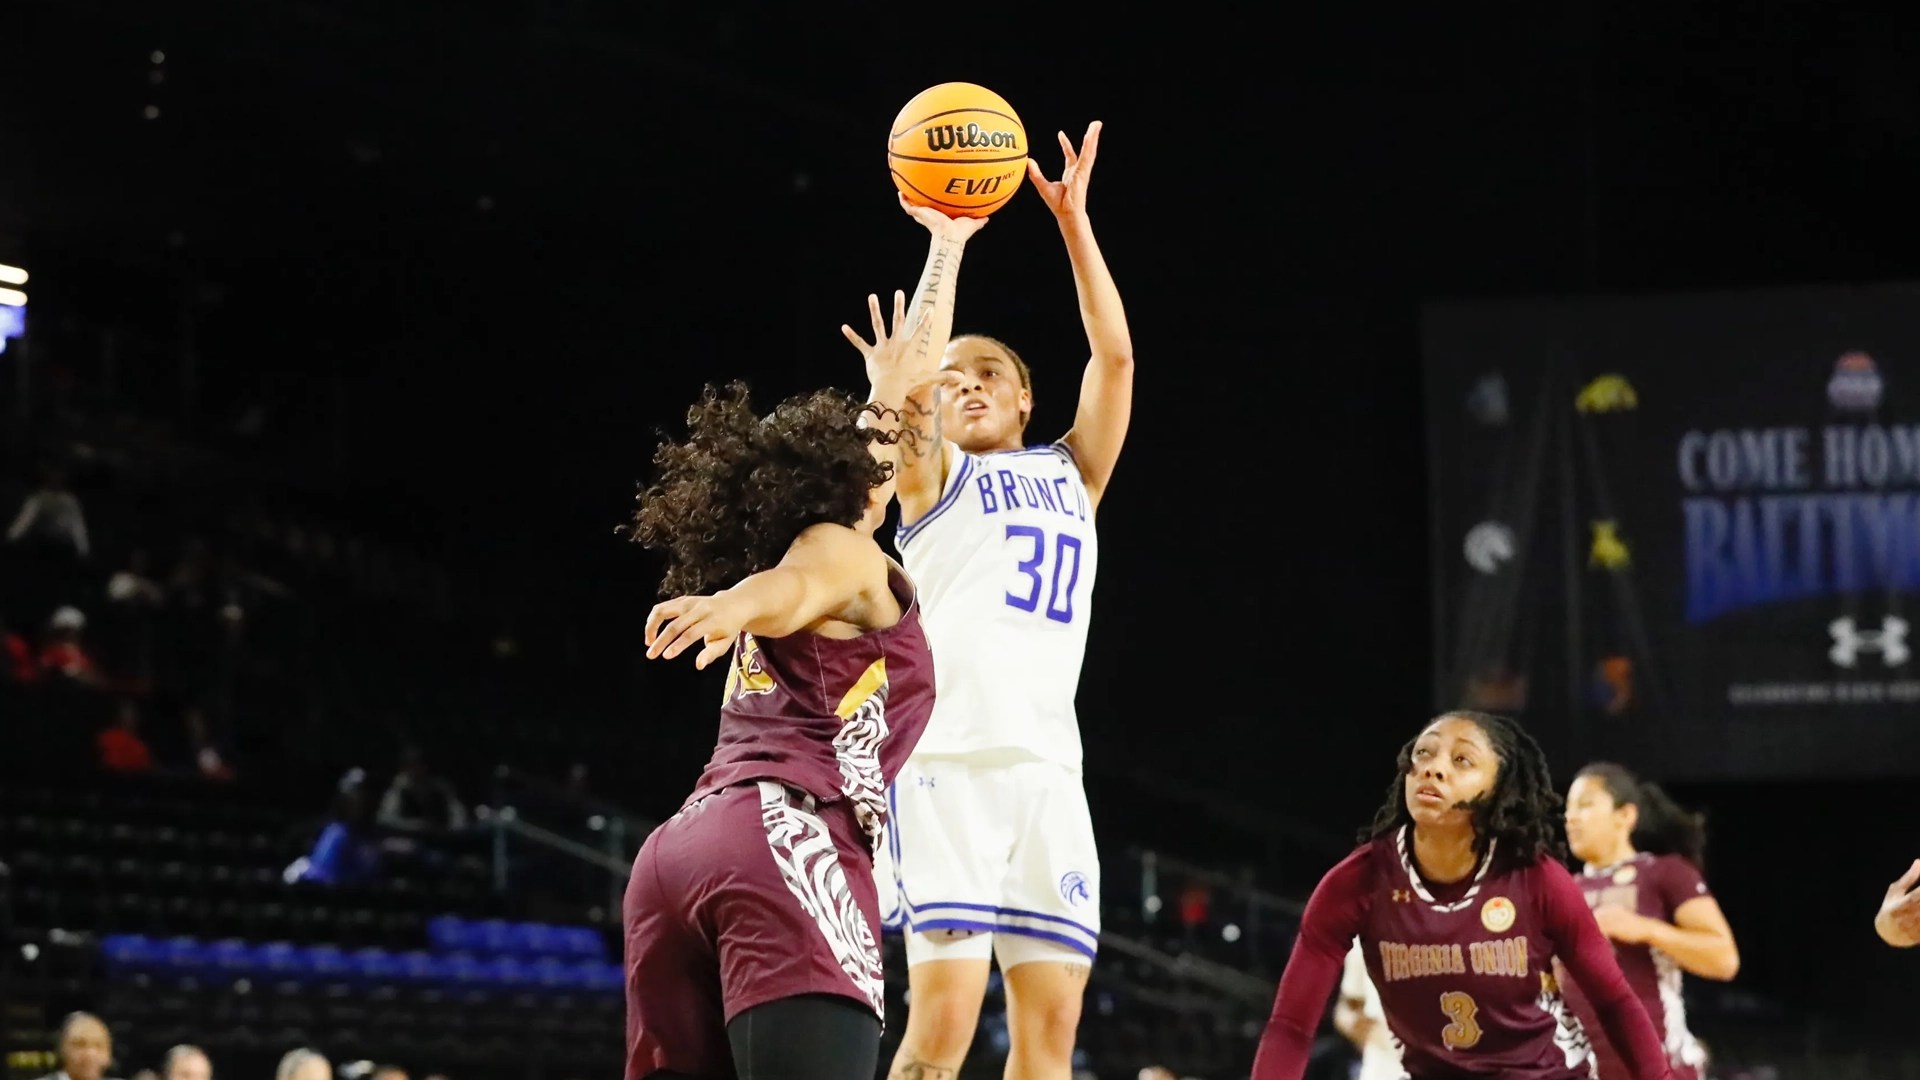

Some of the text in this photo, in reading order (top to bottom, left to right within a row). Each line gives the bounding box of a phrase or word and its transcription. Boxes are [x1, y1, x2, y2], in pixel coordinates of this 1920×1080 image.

[924, 121, 1018, 152] Wilson
[944, 175, 1002, 196] EVO
[1677, 427, 1811, 492] COME
[1005, 524, 1082, 624] 30
[1680, 492, 1920, 628] BALTIM
[1378, 935, 1529, 982] VIRGINIA UNION
[1440, 990, 1484, 1050] 3
